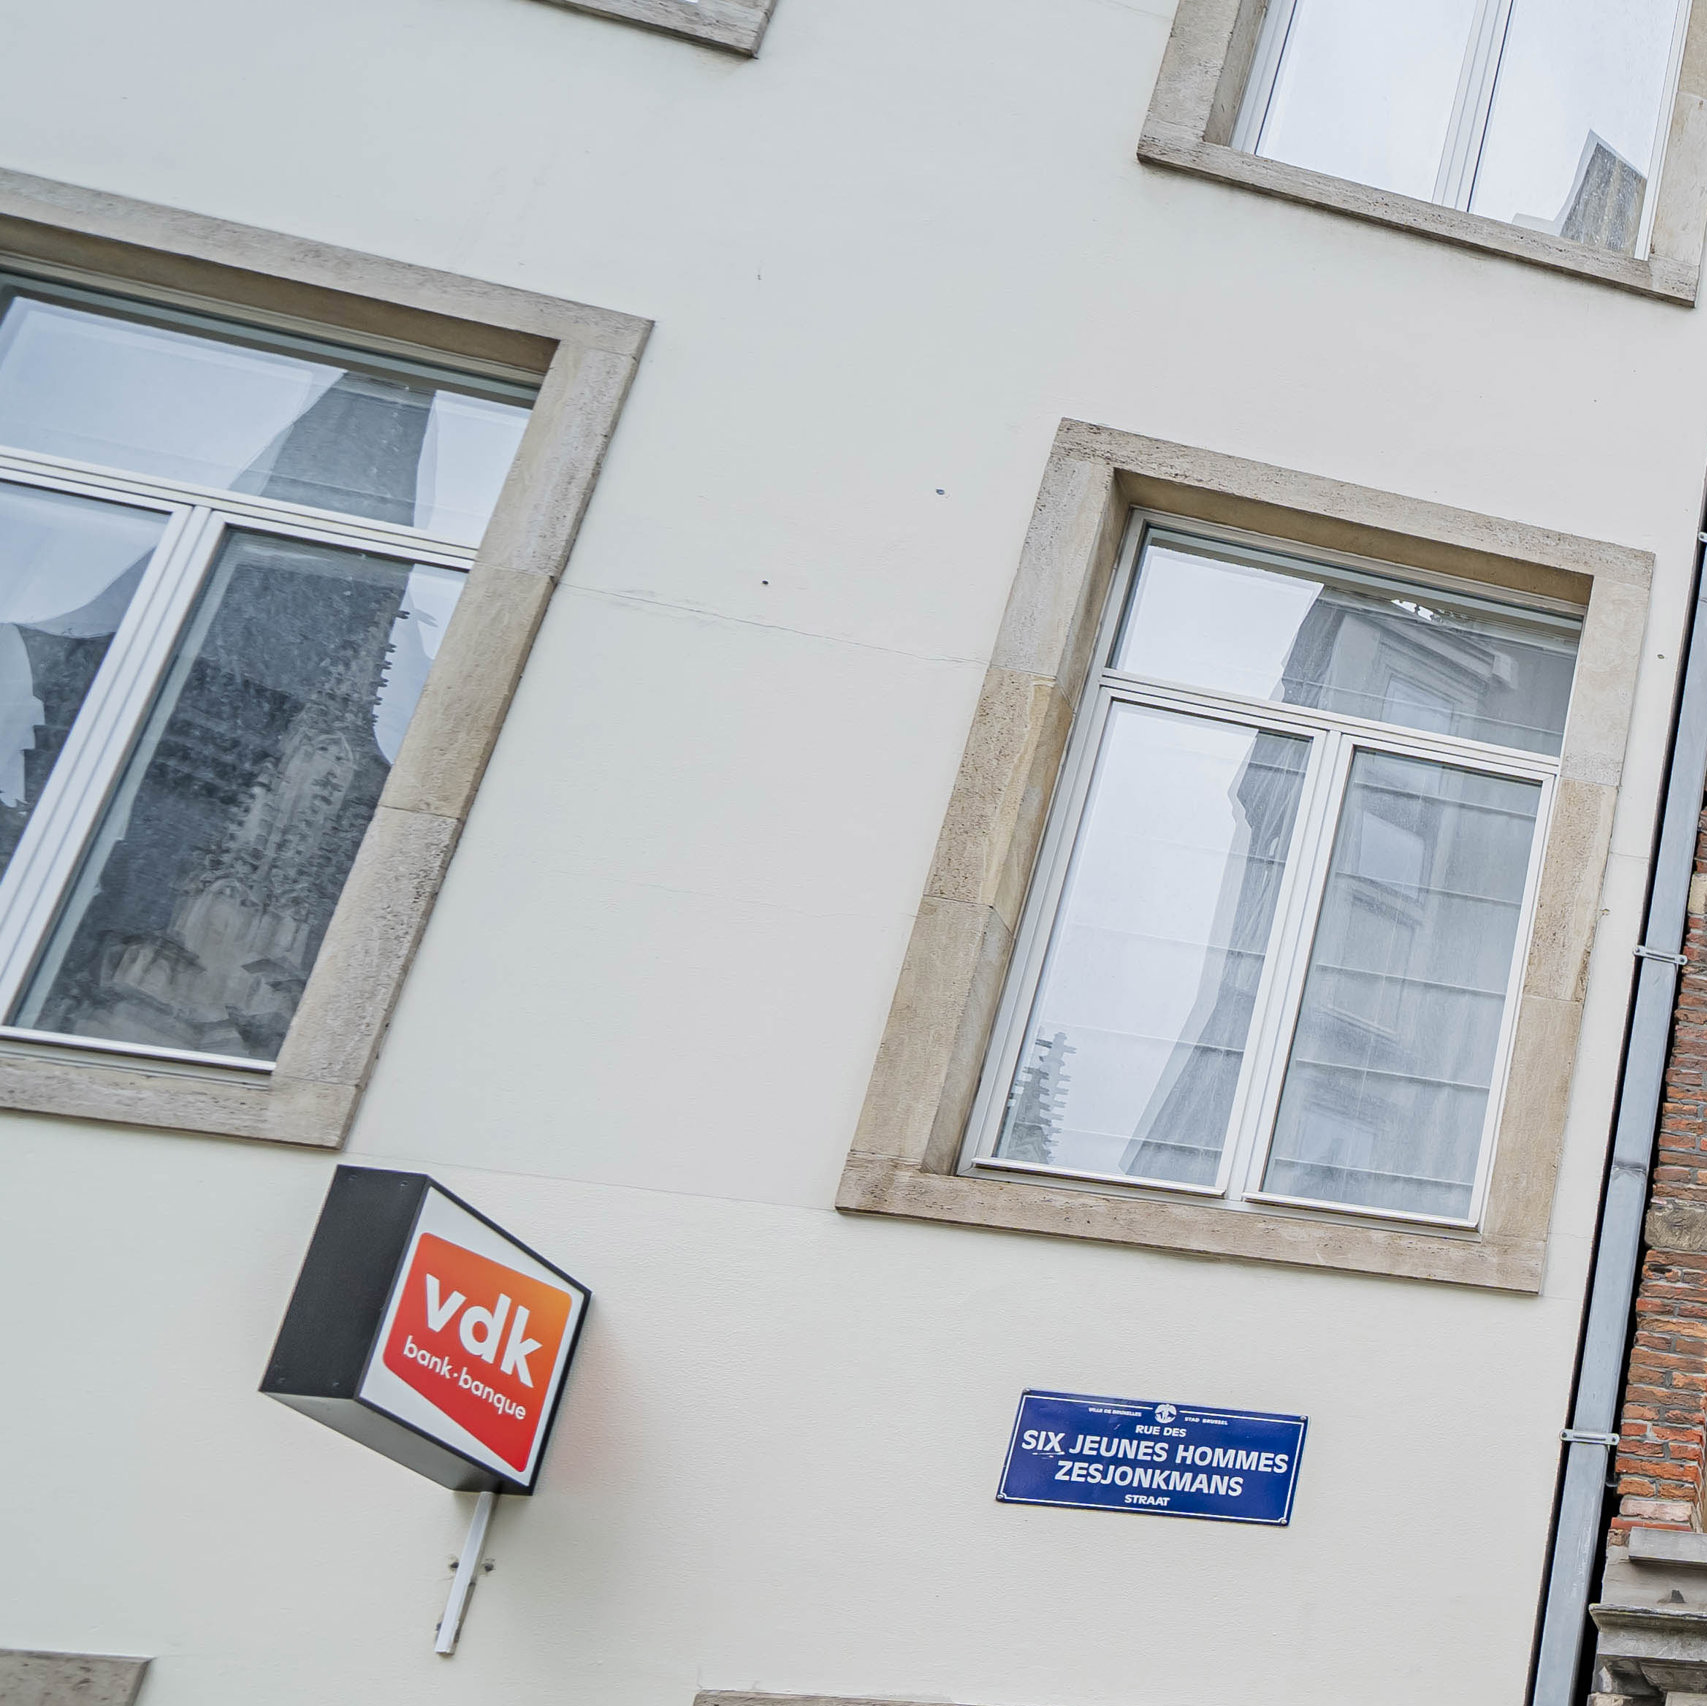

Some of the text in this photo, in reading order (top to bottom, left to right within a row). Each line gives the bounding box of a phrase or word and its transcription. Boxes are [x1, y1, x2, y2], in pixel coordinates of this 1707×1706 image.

[425, 1272, 543, 1389] vdk
[1135, 1425, 1187, 1438] RUE DES
[1021, 1430, 1289, 1474] SIX JEUNES HOMMES
[1054, 1460, 1244, 1496] ZESJONKMANS
[1124, 1494, 1171, 1507] STRAAT
